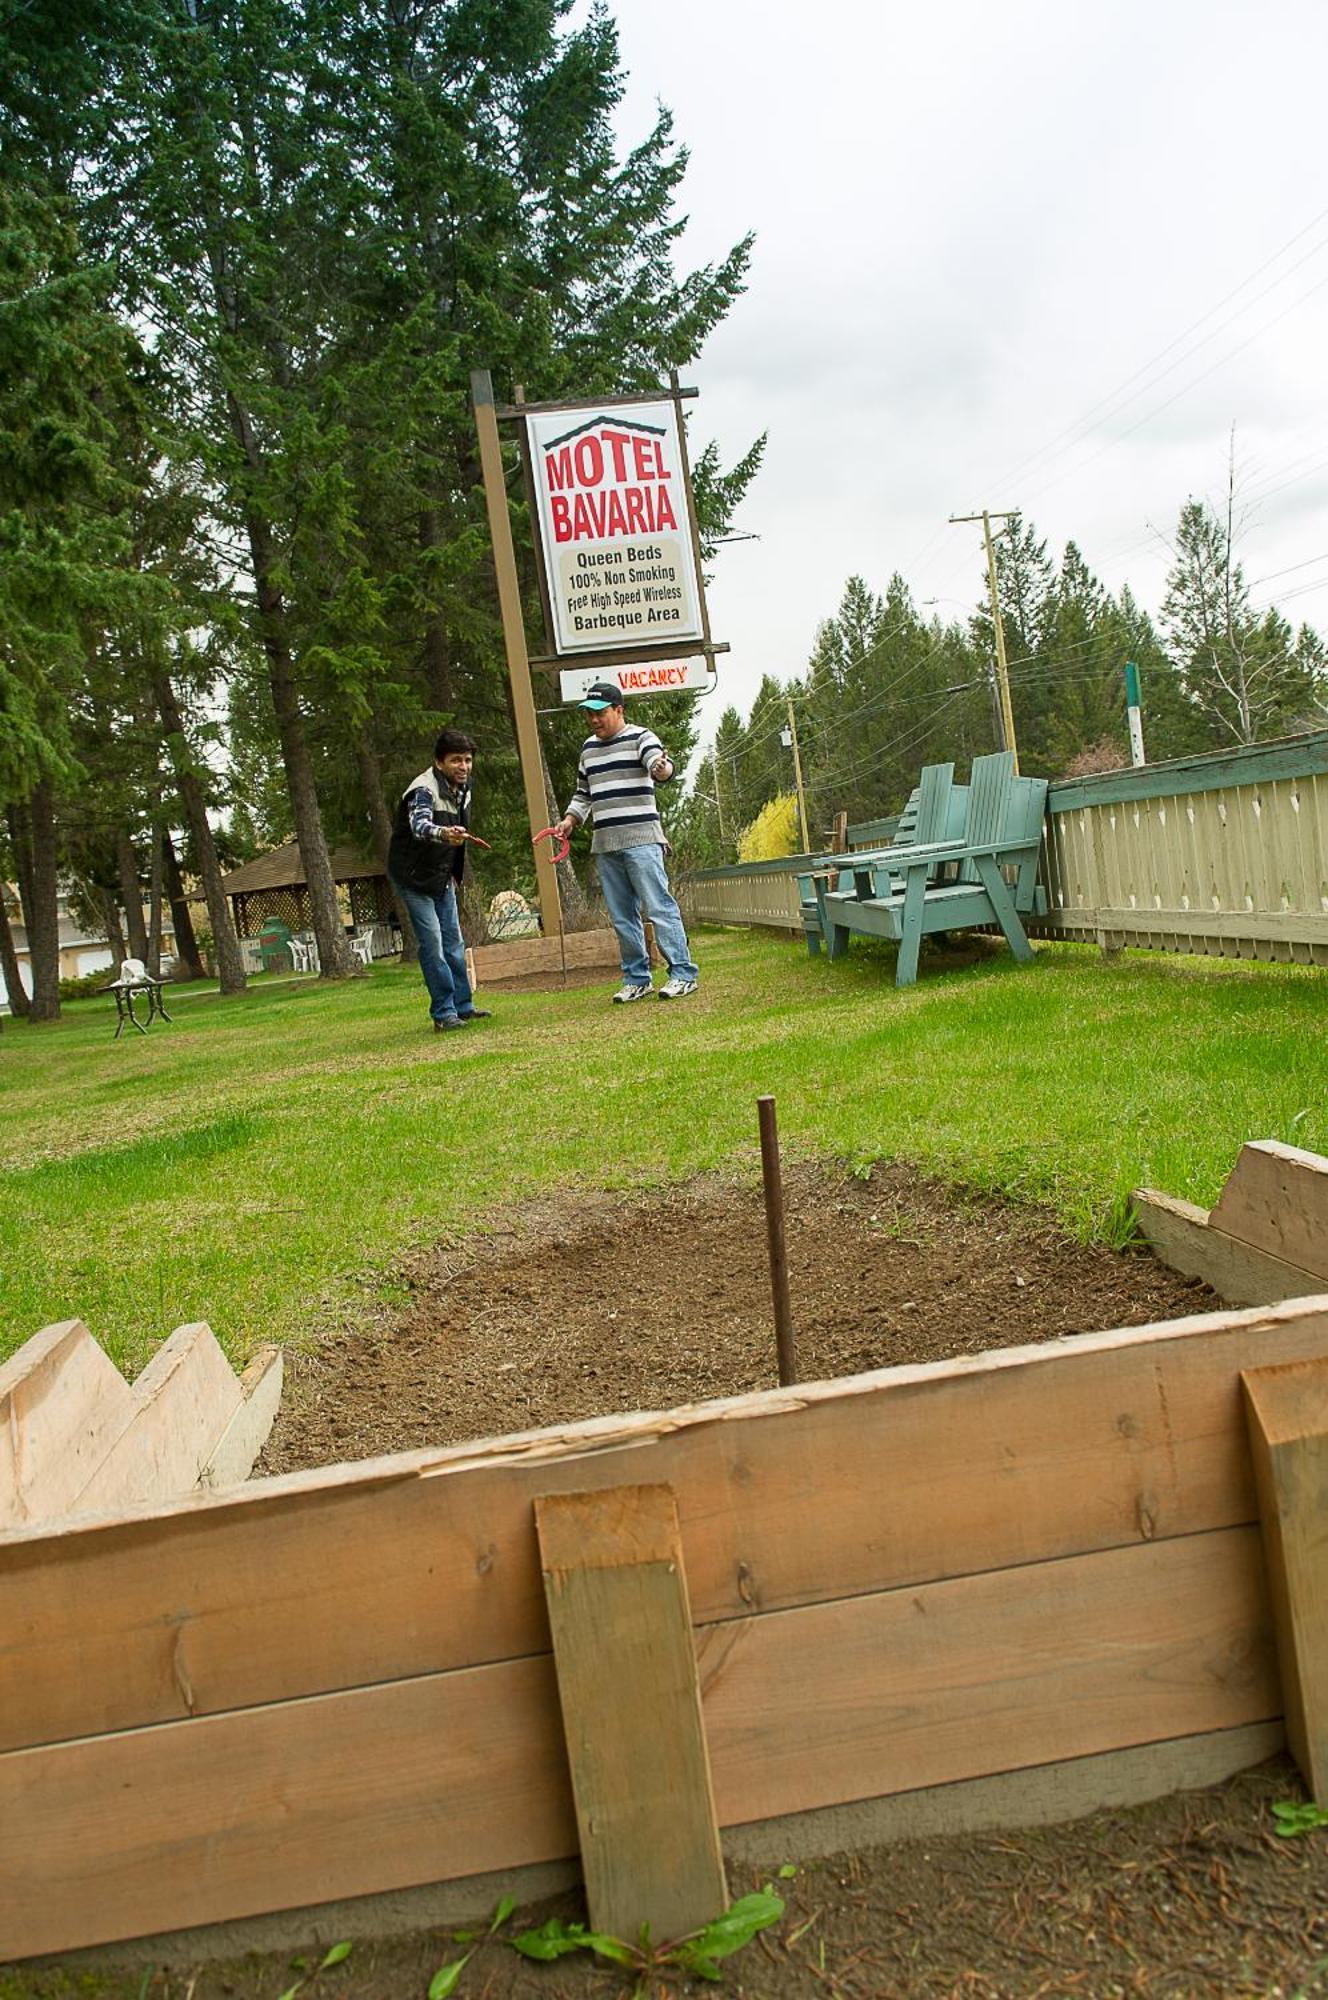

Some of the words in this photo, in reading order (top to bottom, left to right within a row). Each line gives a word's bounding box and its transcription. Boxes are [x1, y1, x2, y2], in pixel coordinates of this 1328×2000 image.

[545, 430, 671, 492] MOTEL
[550, 485, 677, 543] BAVARIA
[577, 550, 622, 568] Queen
[627, 545, 662, 561] Beds
[569, 572, 601, 589] 100%
[604, 570, 626, 585] Non
[629, 566, 676, 584] Smoking
[568, 594, 588, 613] Free
[590, 593, 611, 610] High
[614, 589, 641, 607] Speed
[643, 586, 682, 602] Wireless
[574, 611, 642, 631] Barbeque
[647, 607, 679, 623] Area
[618, 667, 688, 689] VACANCY
